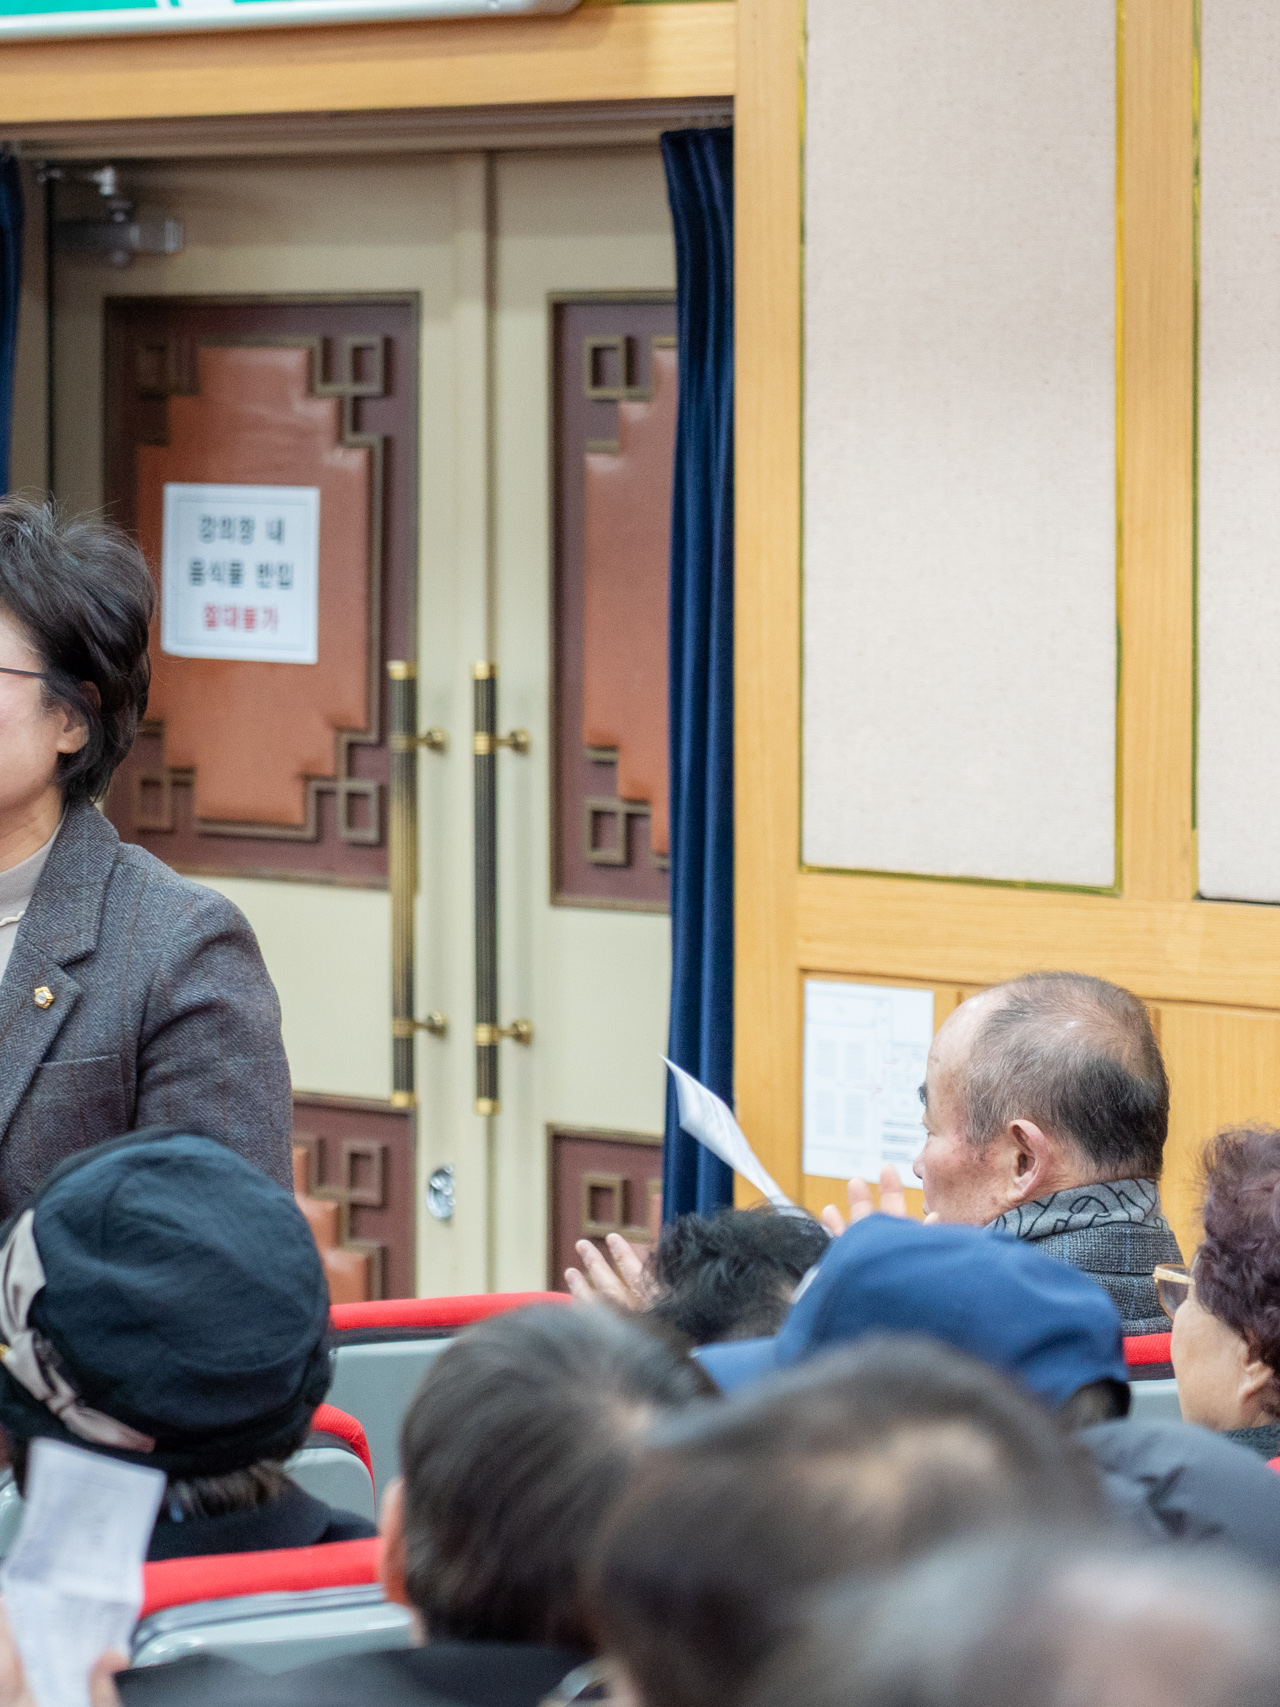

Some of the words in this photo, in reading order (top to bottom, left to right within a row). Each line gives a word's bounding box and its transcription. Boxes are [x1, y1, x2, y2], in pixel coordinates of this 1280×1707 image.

[267, 517, 285, 544] 내
[190, 558, 243, 588] 음식물
[258, 563, 292, 589] 반입
[205, 604, 278, 634] 절대불가
